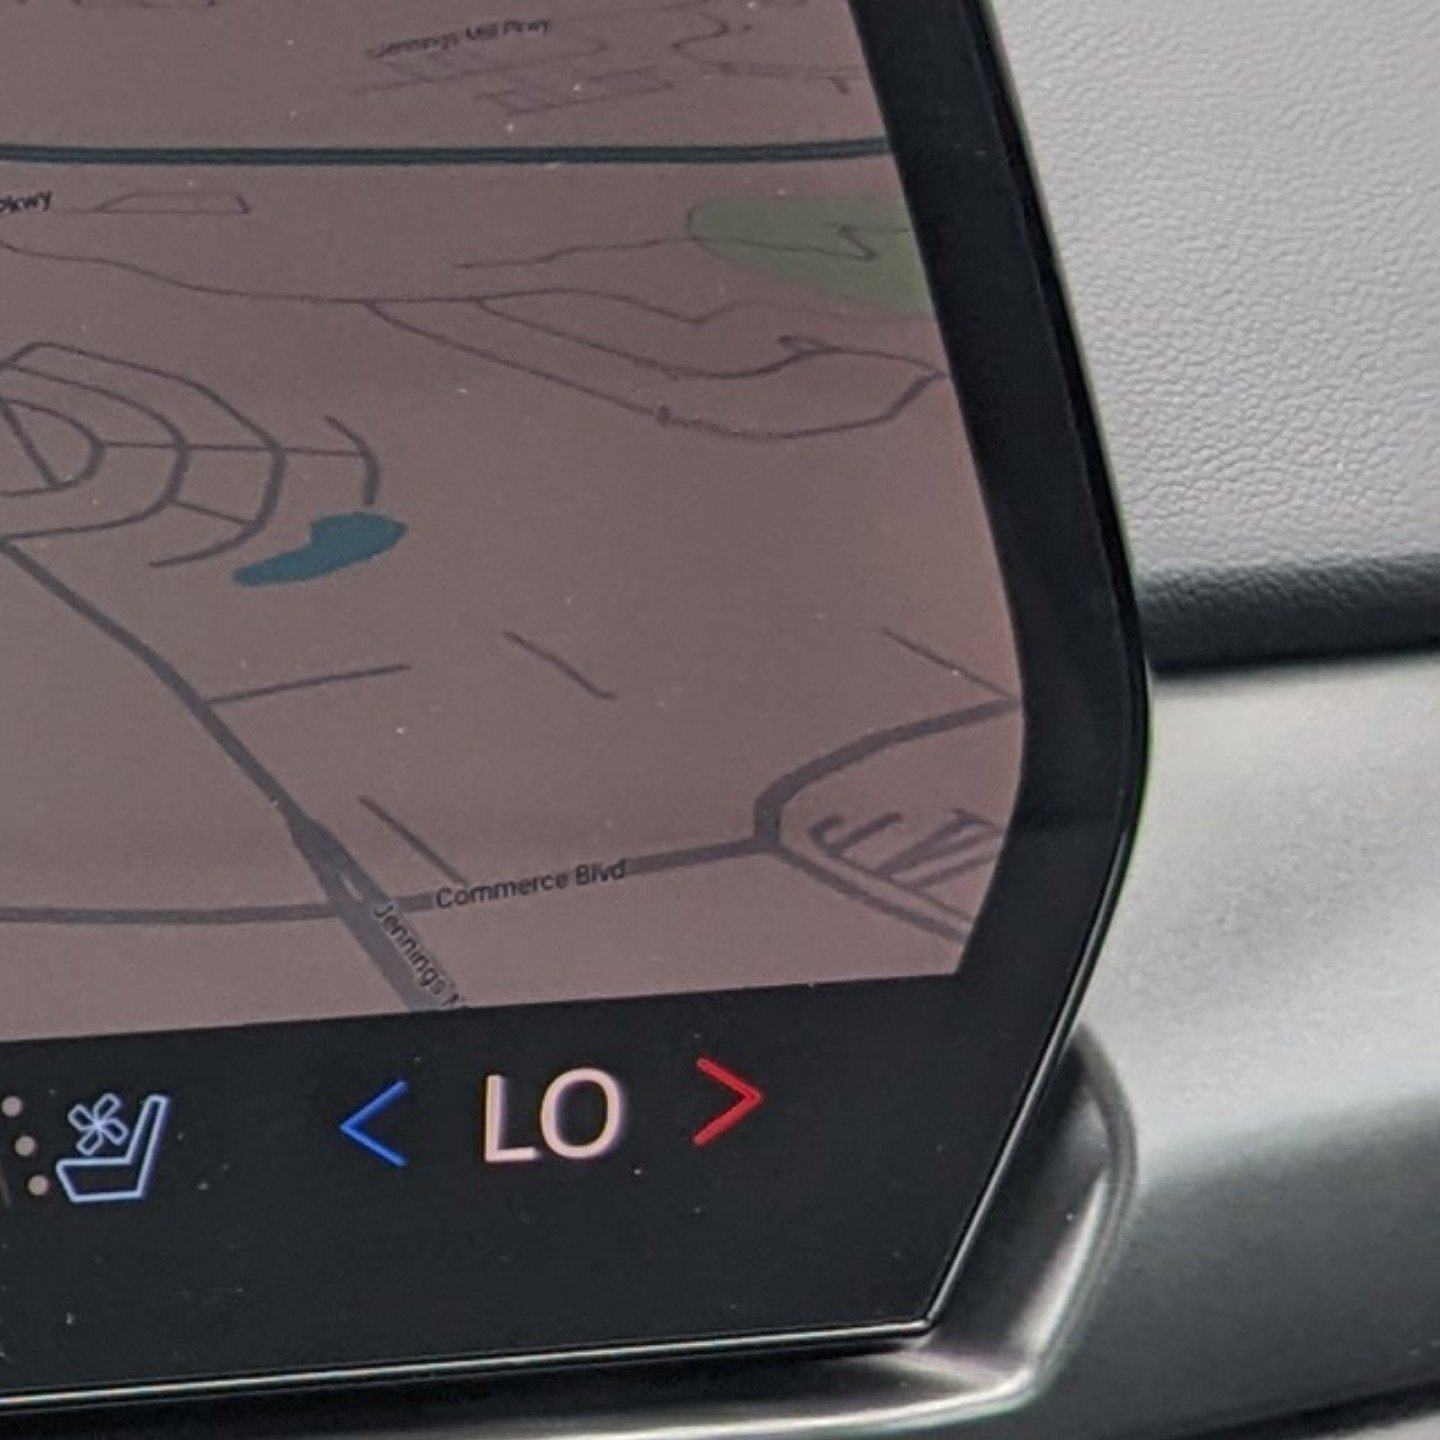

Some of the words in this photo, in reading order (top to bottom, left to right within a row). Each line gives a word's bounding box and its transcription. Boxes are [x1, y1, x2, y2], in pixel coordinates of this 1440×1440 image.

[435, 872, 570, 912] Commerce
[574, 857, 628, 889] Blvd
[373, 903, 446, 996] Jennings
[483, 1066, 626, 1164] LO
